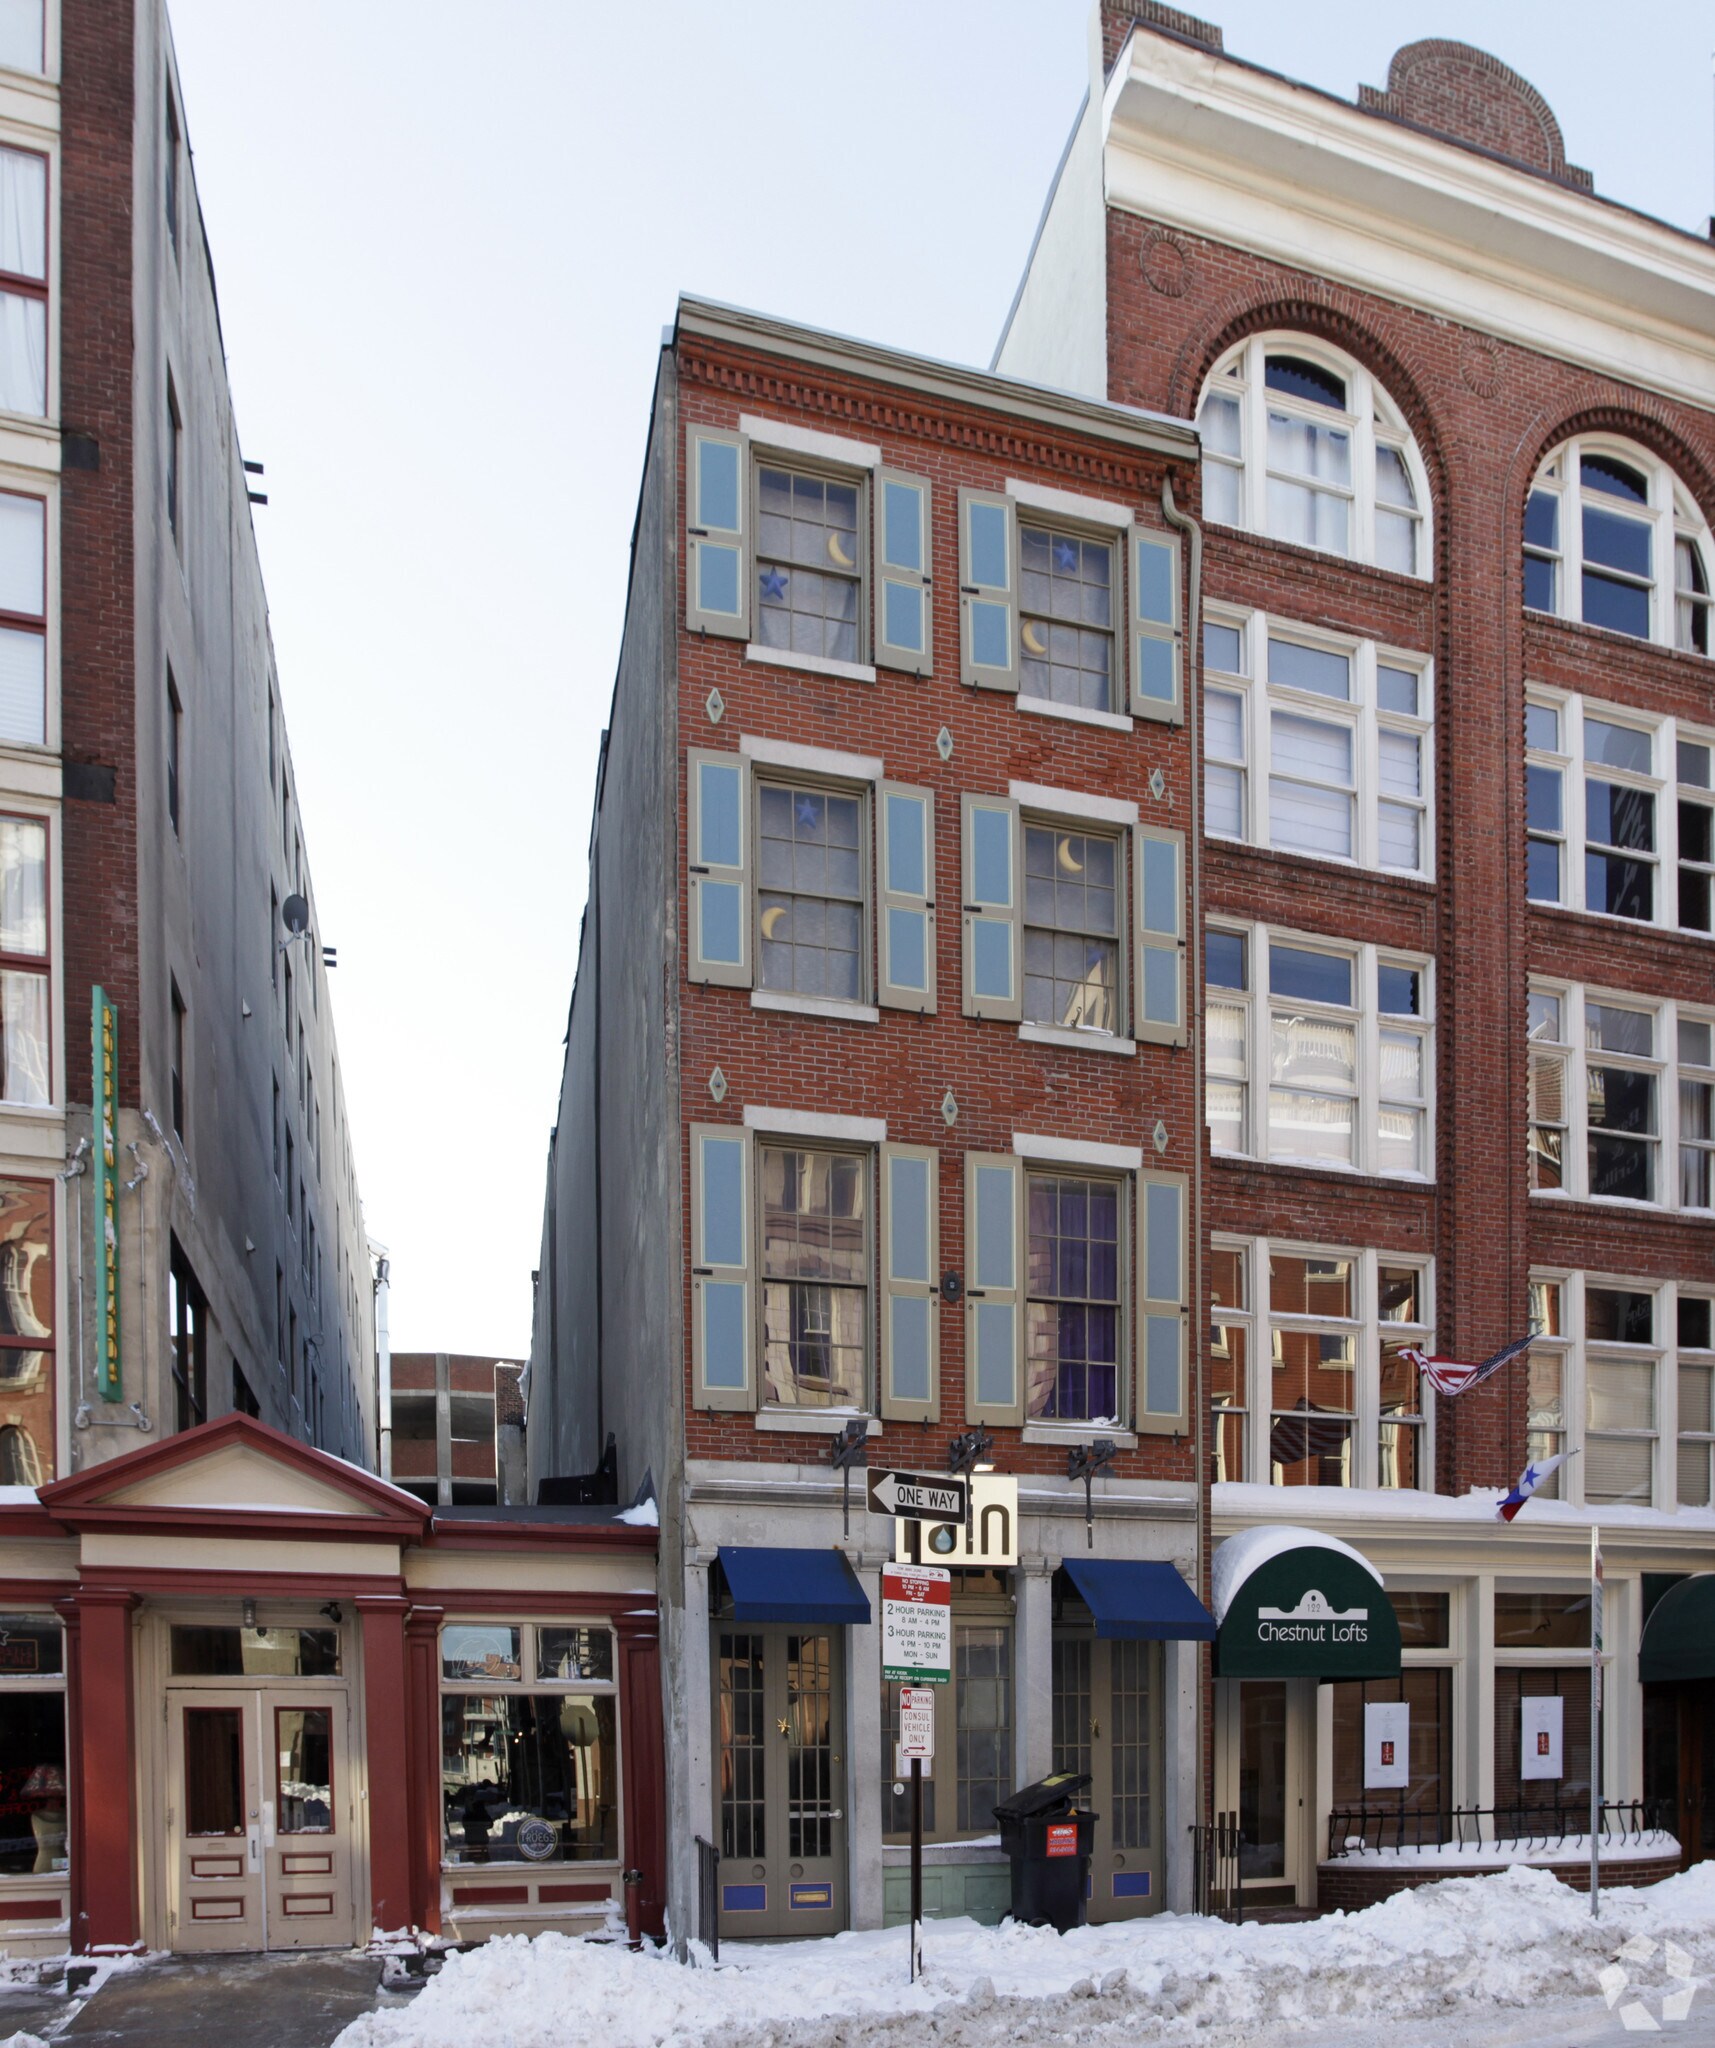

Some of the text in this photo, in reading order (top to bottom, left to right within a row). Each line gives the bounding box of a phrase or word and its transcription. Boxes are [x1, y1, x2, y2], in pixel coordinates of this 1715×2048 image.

[898, 1486, 955, 1509] ONE WAY
[887, 1603, 946, 1617] 2 HOUR PARKING
[1307, 1604, 1320, 1612] 122
[888, 1625, 946, 1640] 3 HOUR PARKING
[1258, 1622, 1368, 1641] Chestnut Lofts
[902, 1693, 932, 1706] NO PARKING
[904, 1712, 930, 1721] CONSUL
[904, 1723, 930, 1732] VEHICLE
[909, 1734, 925, 1743] ONLY
